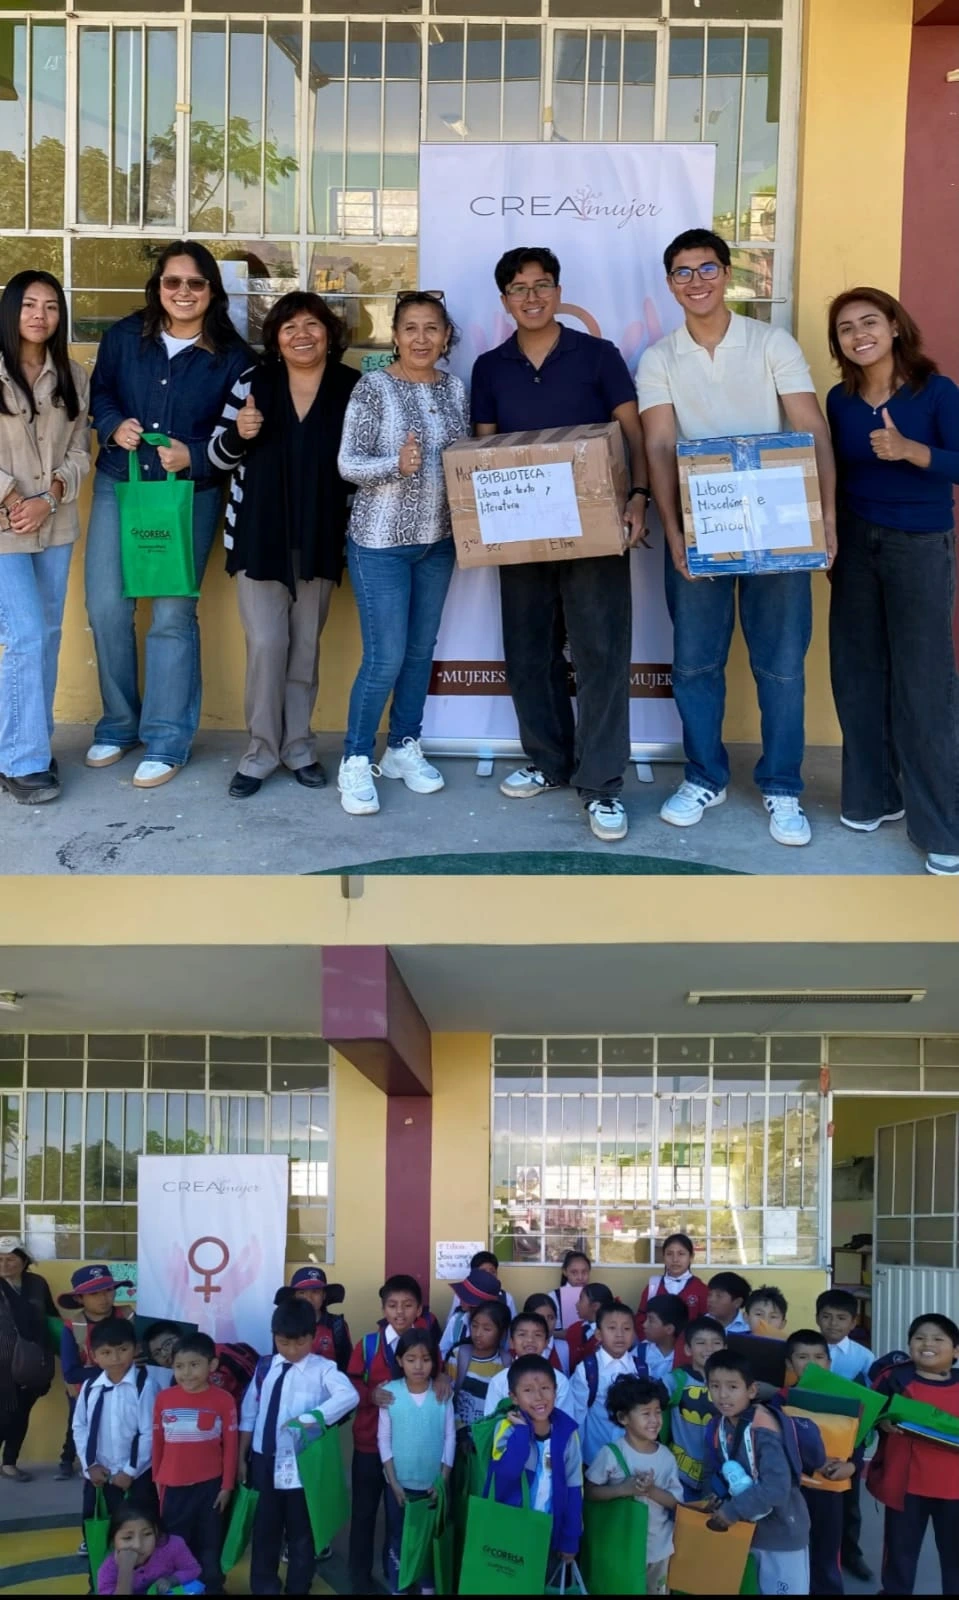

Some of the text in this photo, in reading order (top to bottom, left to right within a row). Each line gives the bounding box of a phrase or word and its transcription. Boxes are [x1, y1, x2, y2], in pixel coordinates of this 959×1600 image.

[470, 195, 663, 229] CREA mujer
[503, 486, 512, 496] de
[757, 496, 766, 505] e
[700, 516, 748, 535] Inicial
[162, 1181, 220, 1193] CREA
